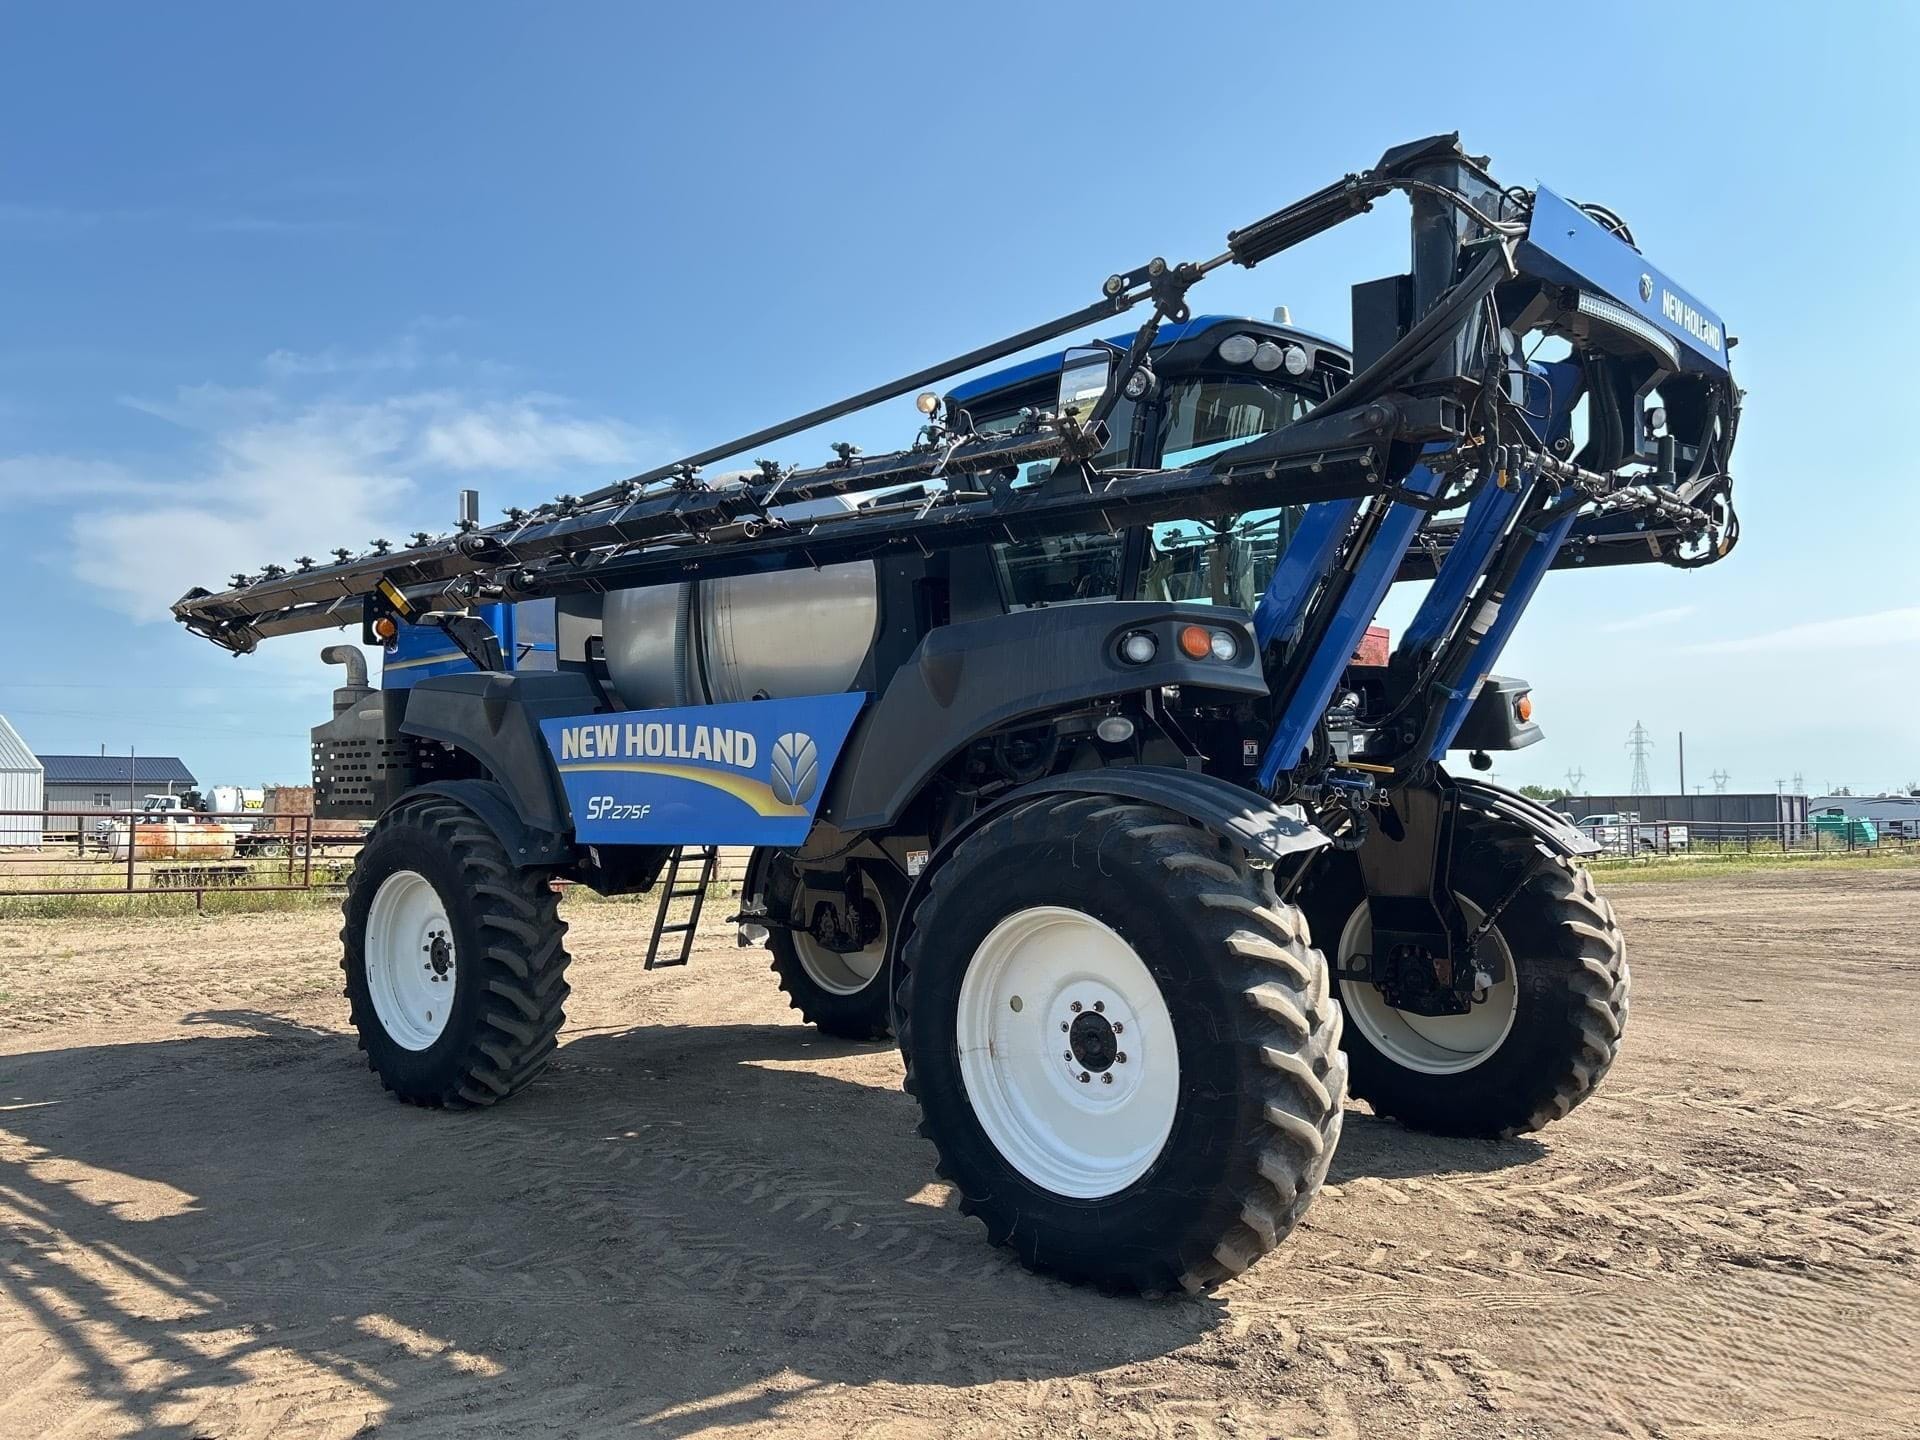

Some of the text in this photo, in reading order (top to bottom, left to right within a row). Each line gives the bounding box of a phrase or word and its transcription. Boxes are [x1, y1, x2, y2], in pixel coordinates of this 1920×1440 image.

[1662, 288, 1720, 352] NEW HOLLAND
[562, 722, 757, 769] NEW HOLLAND
